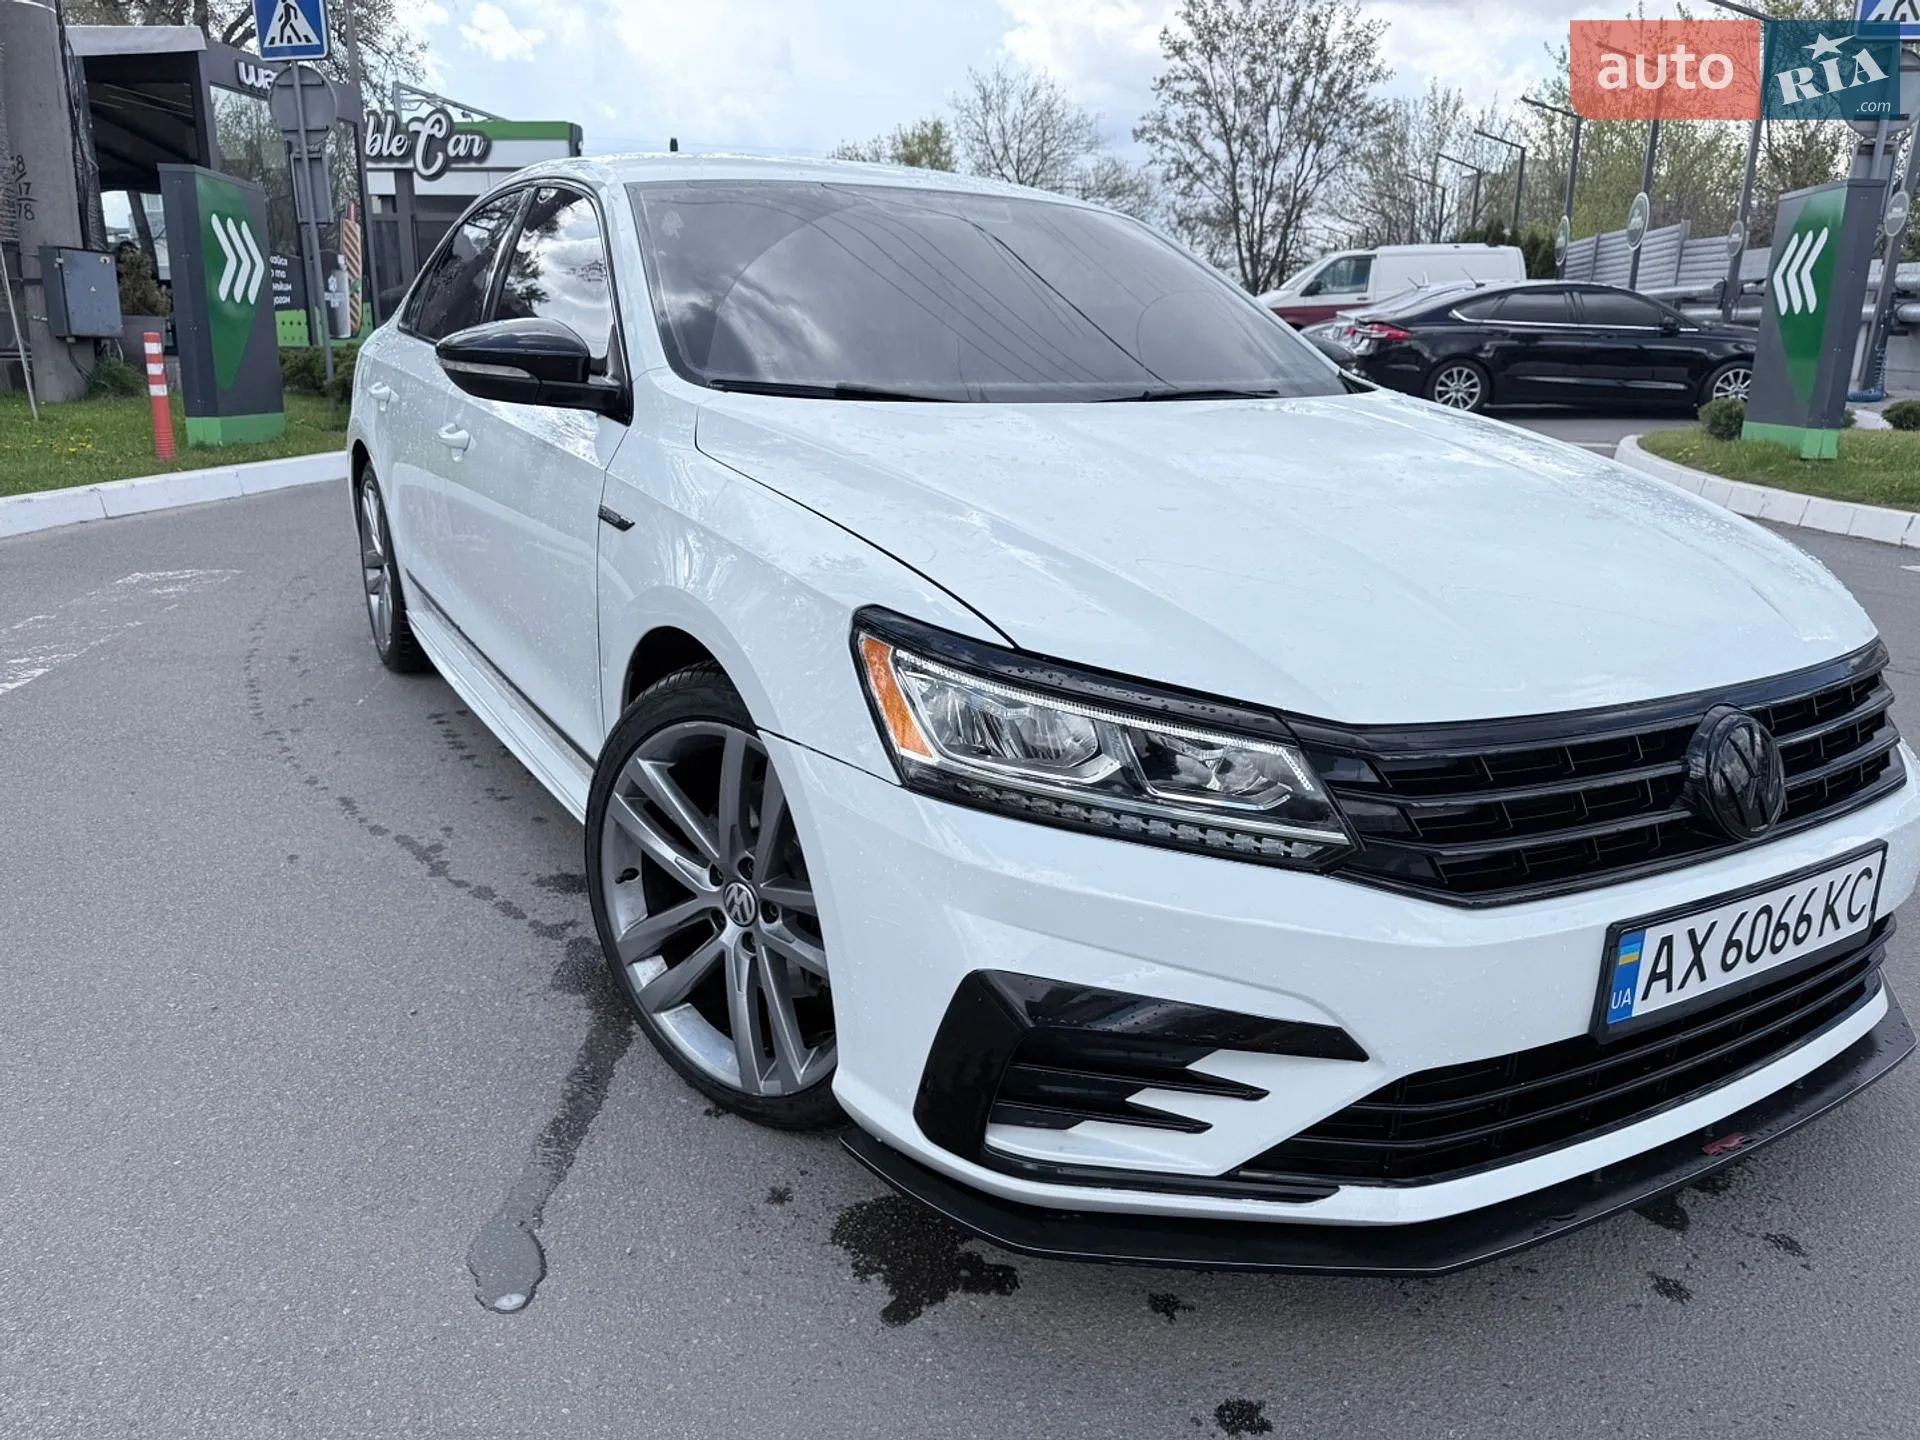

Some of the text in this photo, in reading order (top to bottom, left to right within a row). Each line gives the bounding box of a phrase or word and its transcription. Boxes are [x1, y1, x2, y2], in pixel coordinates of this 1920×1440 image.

[408, 112, 485, 176] Car
[1641, 866, 1873, 1001] AX 6066 KC
[1611, 987, 1631, 1009] UA
